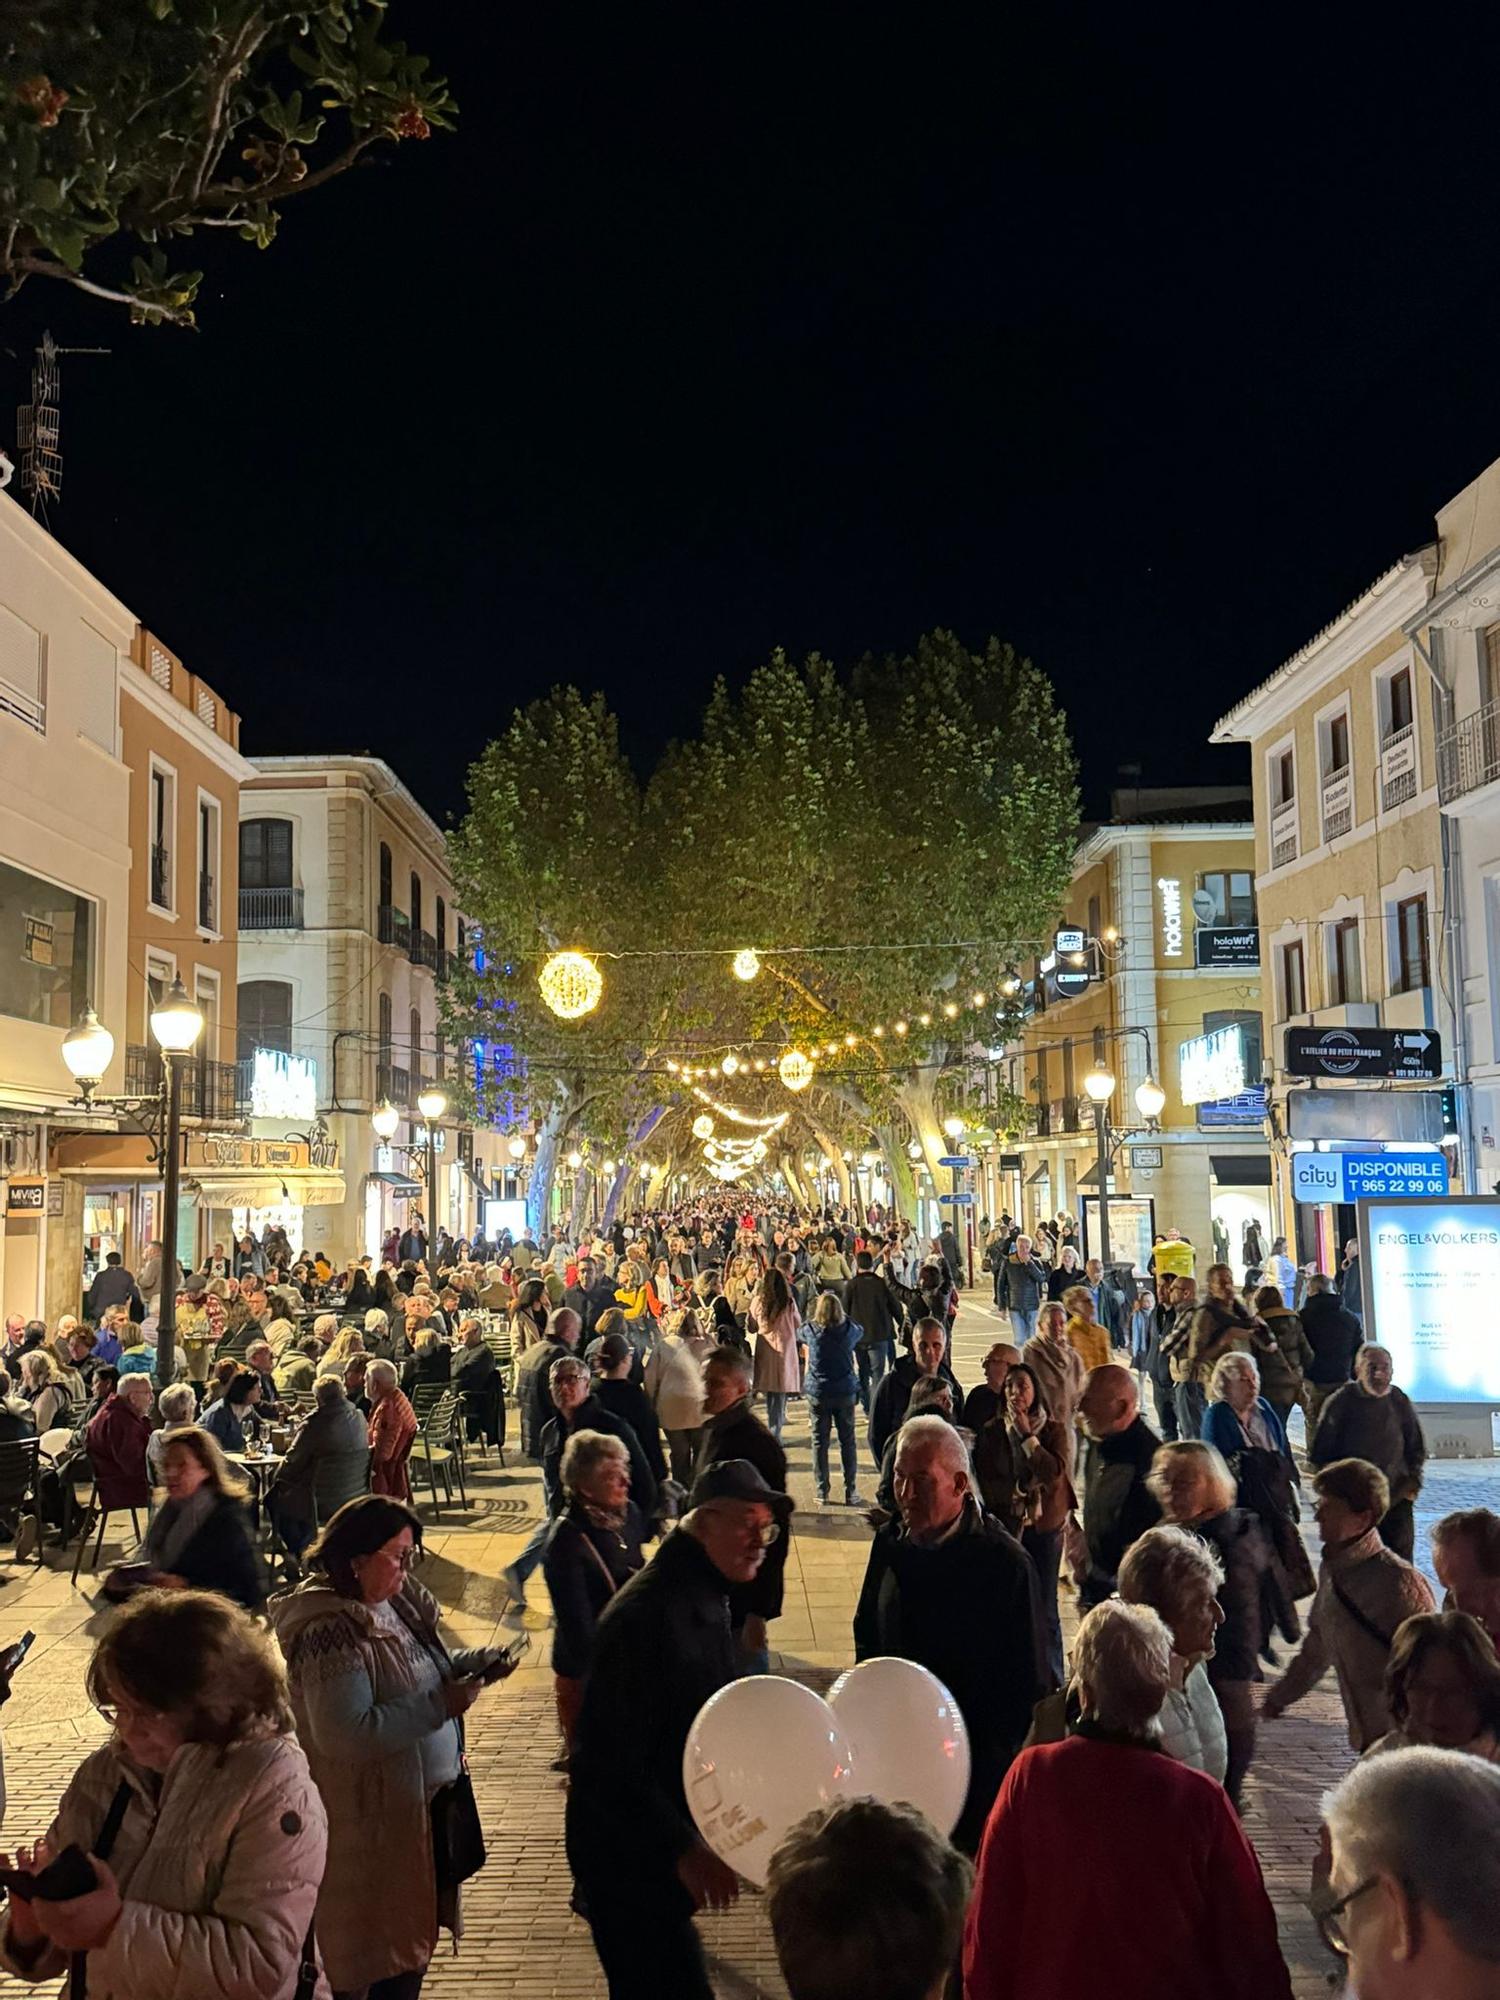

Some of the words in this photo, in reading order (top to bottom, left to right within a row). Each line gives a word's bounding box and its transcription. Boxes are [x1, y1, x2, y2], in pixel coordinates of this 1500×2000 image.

[1337, 1048, 1353, 1056] PETIT
[1353, 1048, 1382, 1059] FRANÇAIS
[1402, 1056, 1421, 1066] 450m
[1348, 1162, 1442, 1176] DISPONIBLE
[1299, 1164, 1337, 1188] city
[1349, 1179, 1359, 1191] T
[1362, 1180, 1386, 1192] 965
[1389, 1180, 1405, 1192] 22
[1408, 1180, 1424, 1192] 99
[1427, 1180, 1443, 1192] 06
